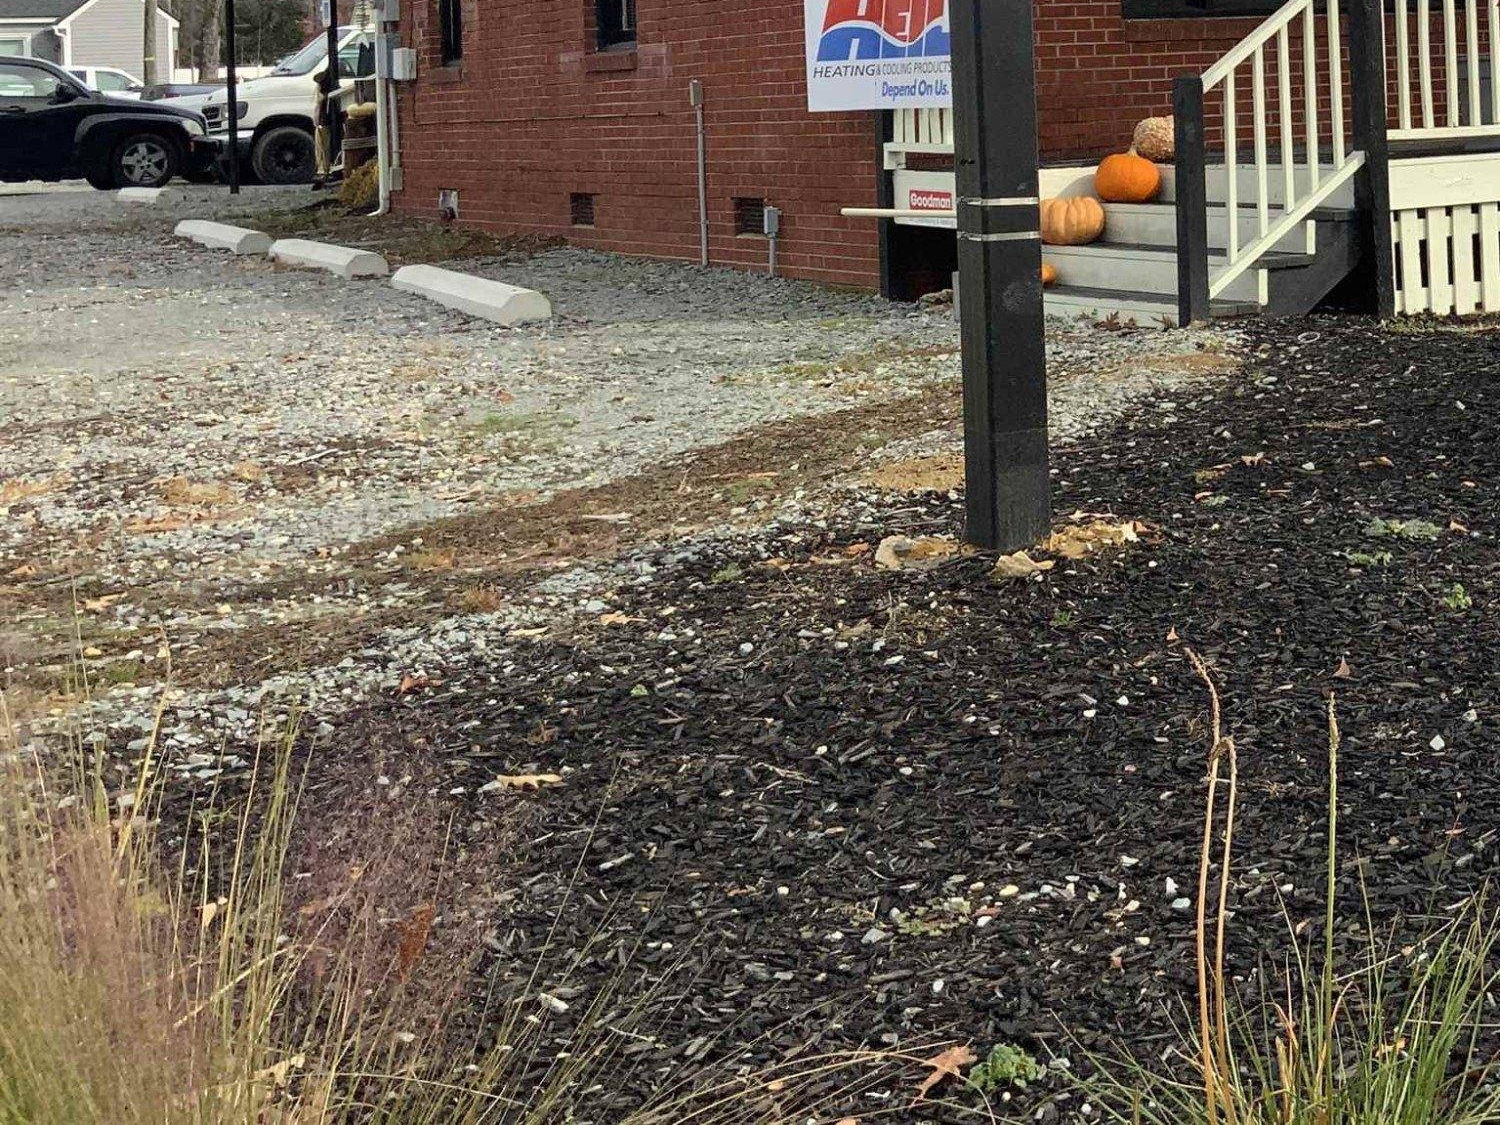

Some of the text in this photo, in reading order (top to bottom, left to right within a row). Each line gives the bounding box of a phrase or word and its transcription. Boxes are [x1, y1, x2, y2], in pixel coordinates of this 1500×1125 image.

[813, 63, 875, 78] HEATING
[882, 62, 912, 75] COOLING
[881, 78, 950, 100] Depend On Us.
[910, 192, 951, 209] Goodman
